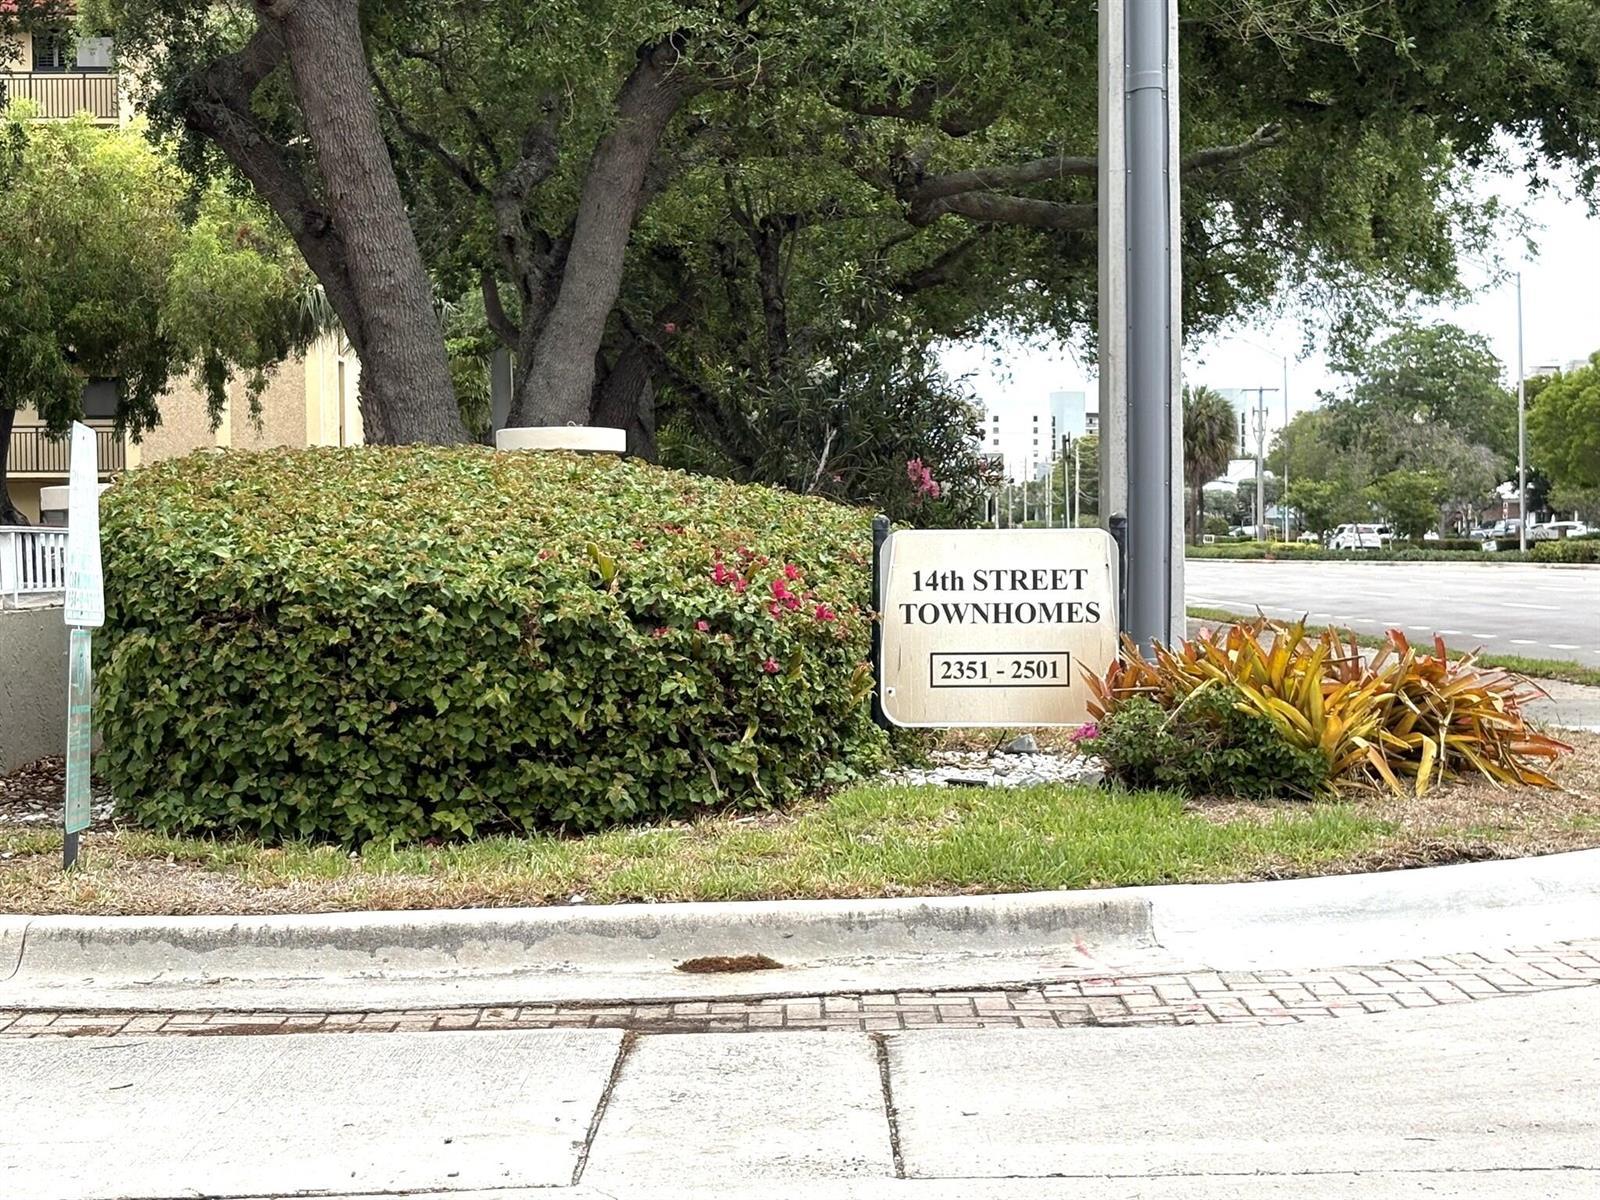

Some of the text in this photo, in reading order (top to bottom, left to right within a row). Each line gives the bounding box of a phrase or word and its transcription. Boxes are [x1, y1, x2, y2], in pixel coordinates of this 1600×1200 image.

[912, 568, 1088, 592] 14th STREET
[899, 601, 1101, 625] TOWNHOMES
[940, 660, 989, 680] 2351
[1010, 659, 1061, 680] 2501
